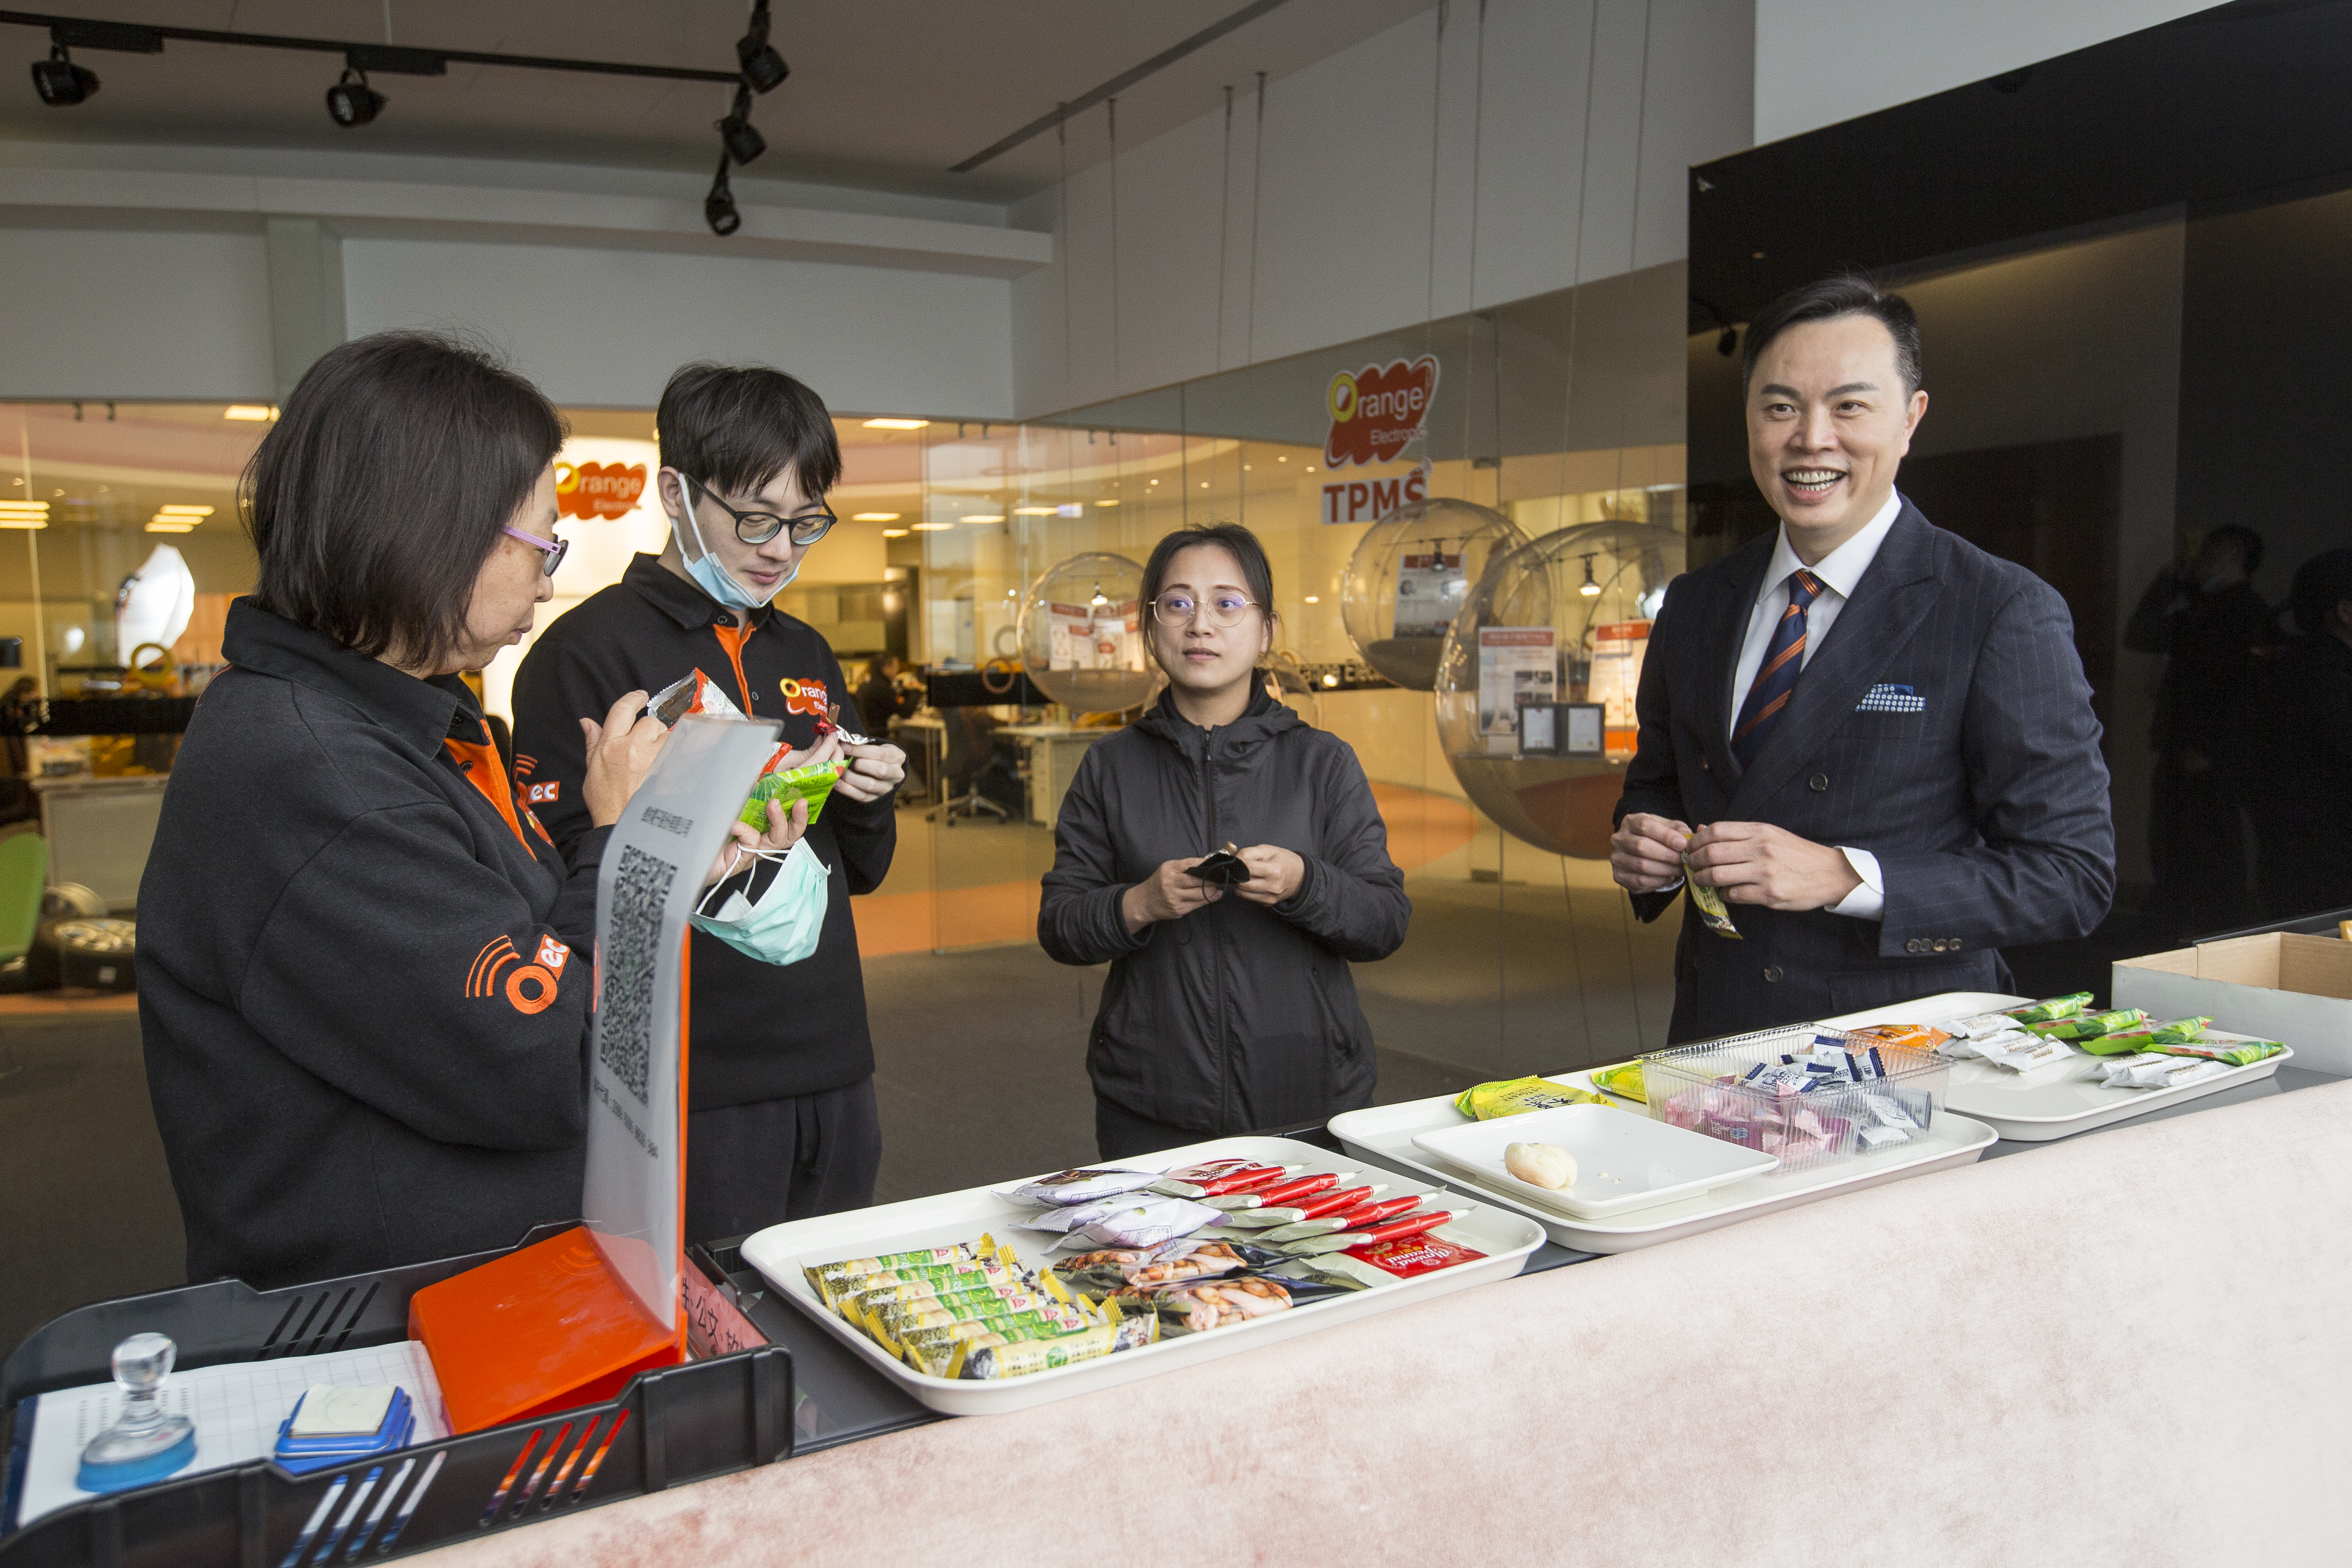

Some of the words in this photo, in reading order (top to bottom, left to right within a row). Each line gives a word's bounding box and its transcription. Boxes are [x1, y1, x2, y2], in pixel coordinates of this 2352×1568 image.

[1329, 372, 1424, 423] Orange
[1323, 476, 1426, 523] TPMS
[780, 677, 827, 705] Orang
[1385, 1244, 1437, 1263] Peanut
[1397, 1248, 1450, 1266] Almond
